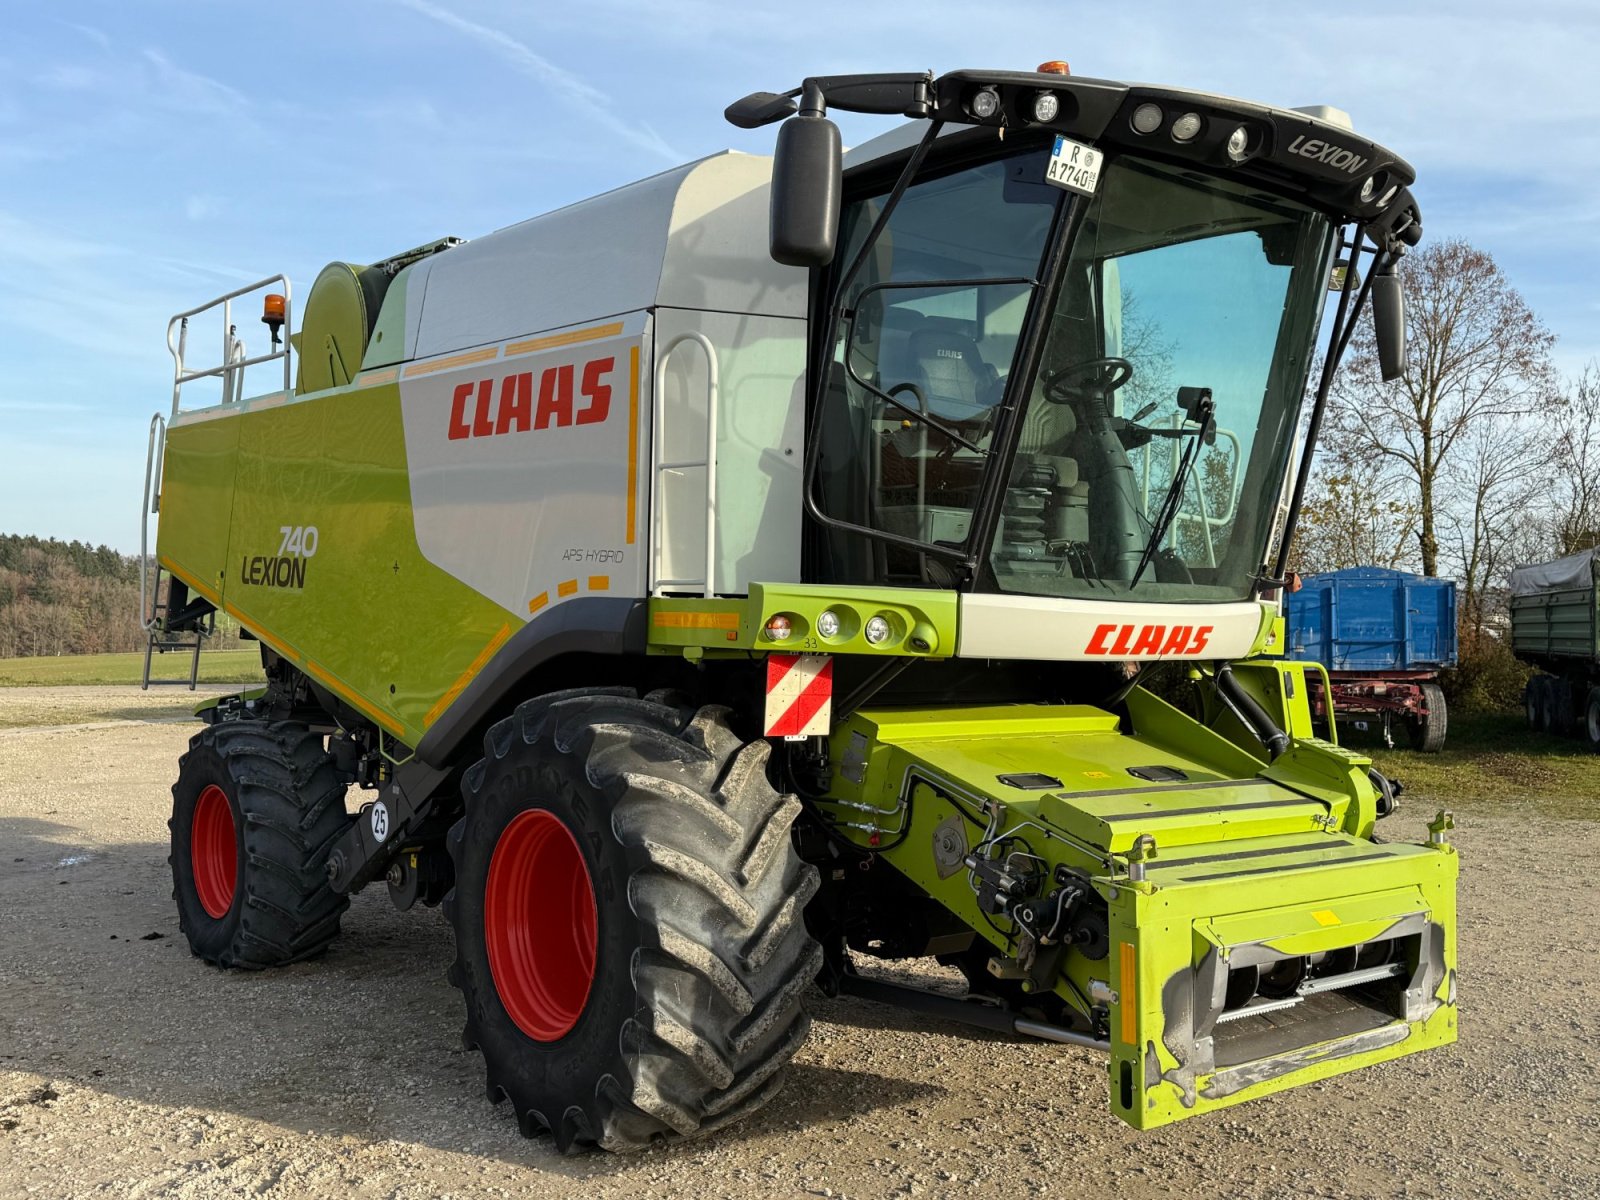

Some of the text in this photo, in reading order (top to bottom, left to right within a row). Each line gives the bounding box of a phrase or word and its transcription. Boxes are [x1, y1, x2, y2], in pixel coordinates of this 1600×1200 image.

[1070, 145, 1080, 163] R
[1287, 135, 1368, 174] LEXION
[937, 349, 962, 359] CLAAS
[448, 356, 615, 440] CLAAS
[277, 526, 319, 558] 740
[562, 548, 624, 563] APS HYBRID
[241, 556, 307, 588] LEXION
[1084, 624, 1214, 655] CLAAS
[374, 809, 386, 835] 25
